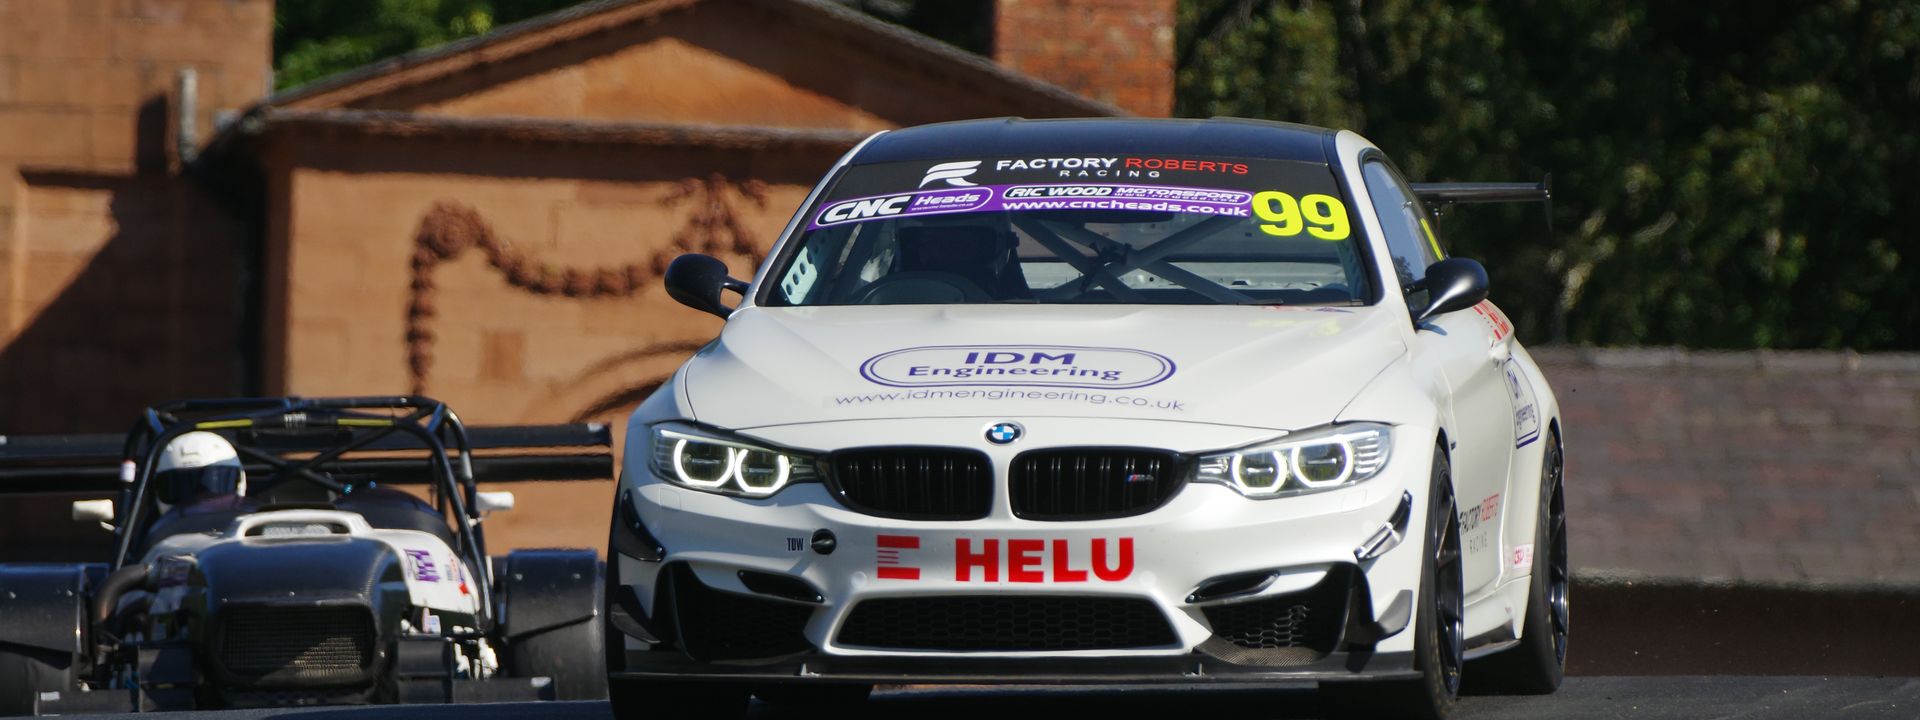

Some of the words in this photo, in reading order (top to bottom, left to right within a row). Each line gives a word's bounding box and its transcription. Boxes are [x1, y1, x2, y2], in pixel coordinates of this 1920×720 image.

[996, 157, 1119, 171] FACTORY
[1124, 158, 1249, 175] ROBERTS
[1059, 169, 1161, 178] RACING
[1009, 187, 1042, 197] RIC
[1048, 187, 1113, 197] WOOD
[1115, 187, 1245, 200] MOTORSPORT
[824, 195, 912, 222] CNC
[914, 194, 981, 206] Heads
[1002, 199, 1249, 216] www.cncheads.co.uk
[1251, 190, 1351, 240] 99
[963, 351, 1077, 365] IDM
[907, 364, 1124, 381] Engineering
[834, 387, 1185, 412] www.idmengineering.co.uk
[786, 537, 804, 552] TOW
[954, 536, 1135, 583] HELU
